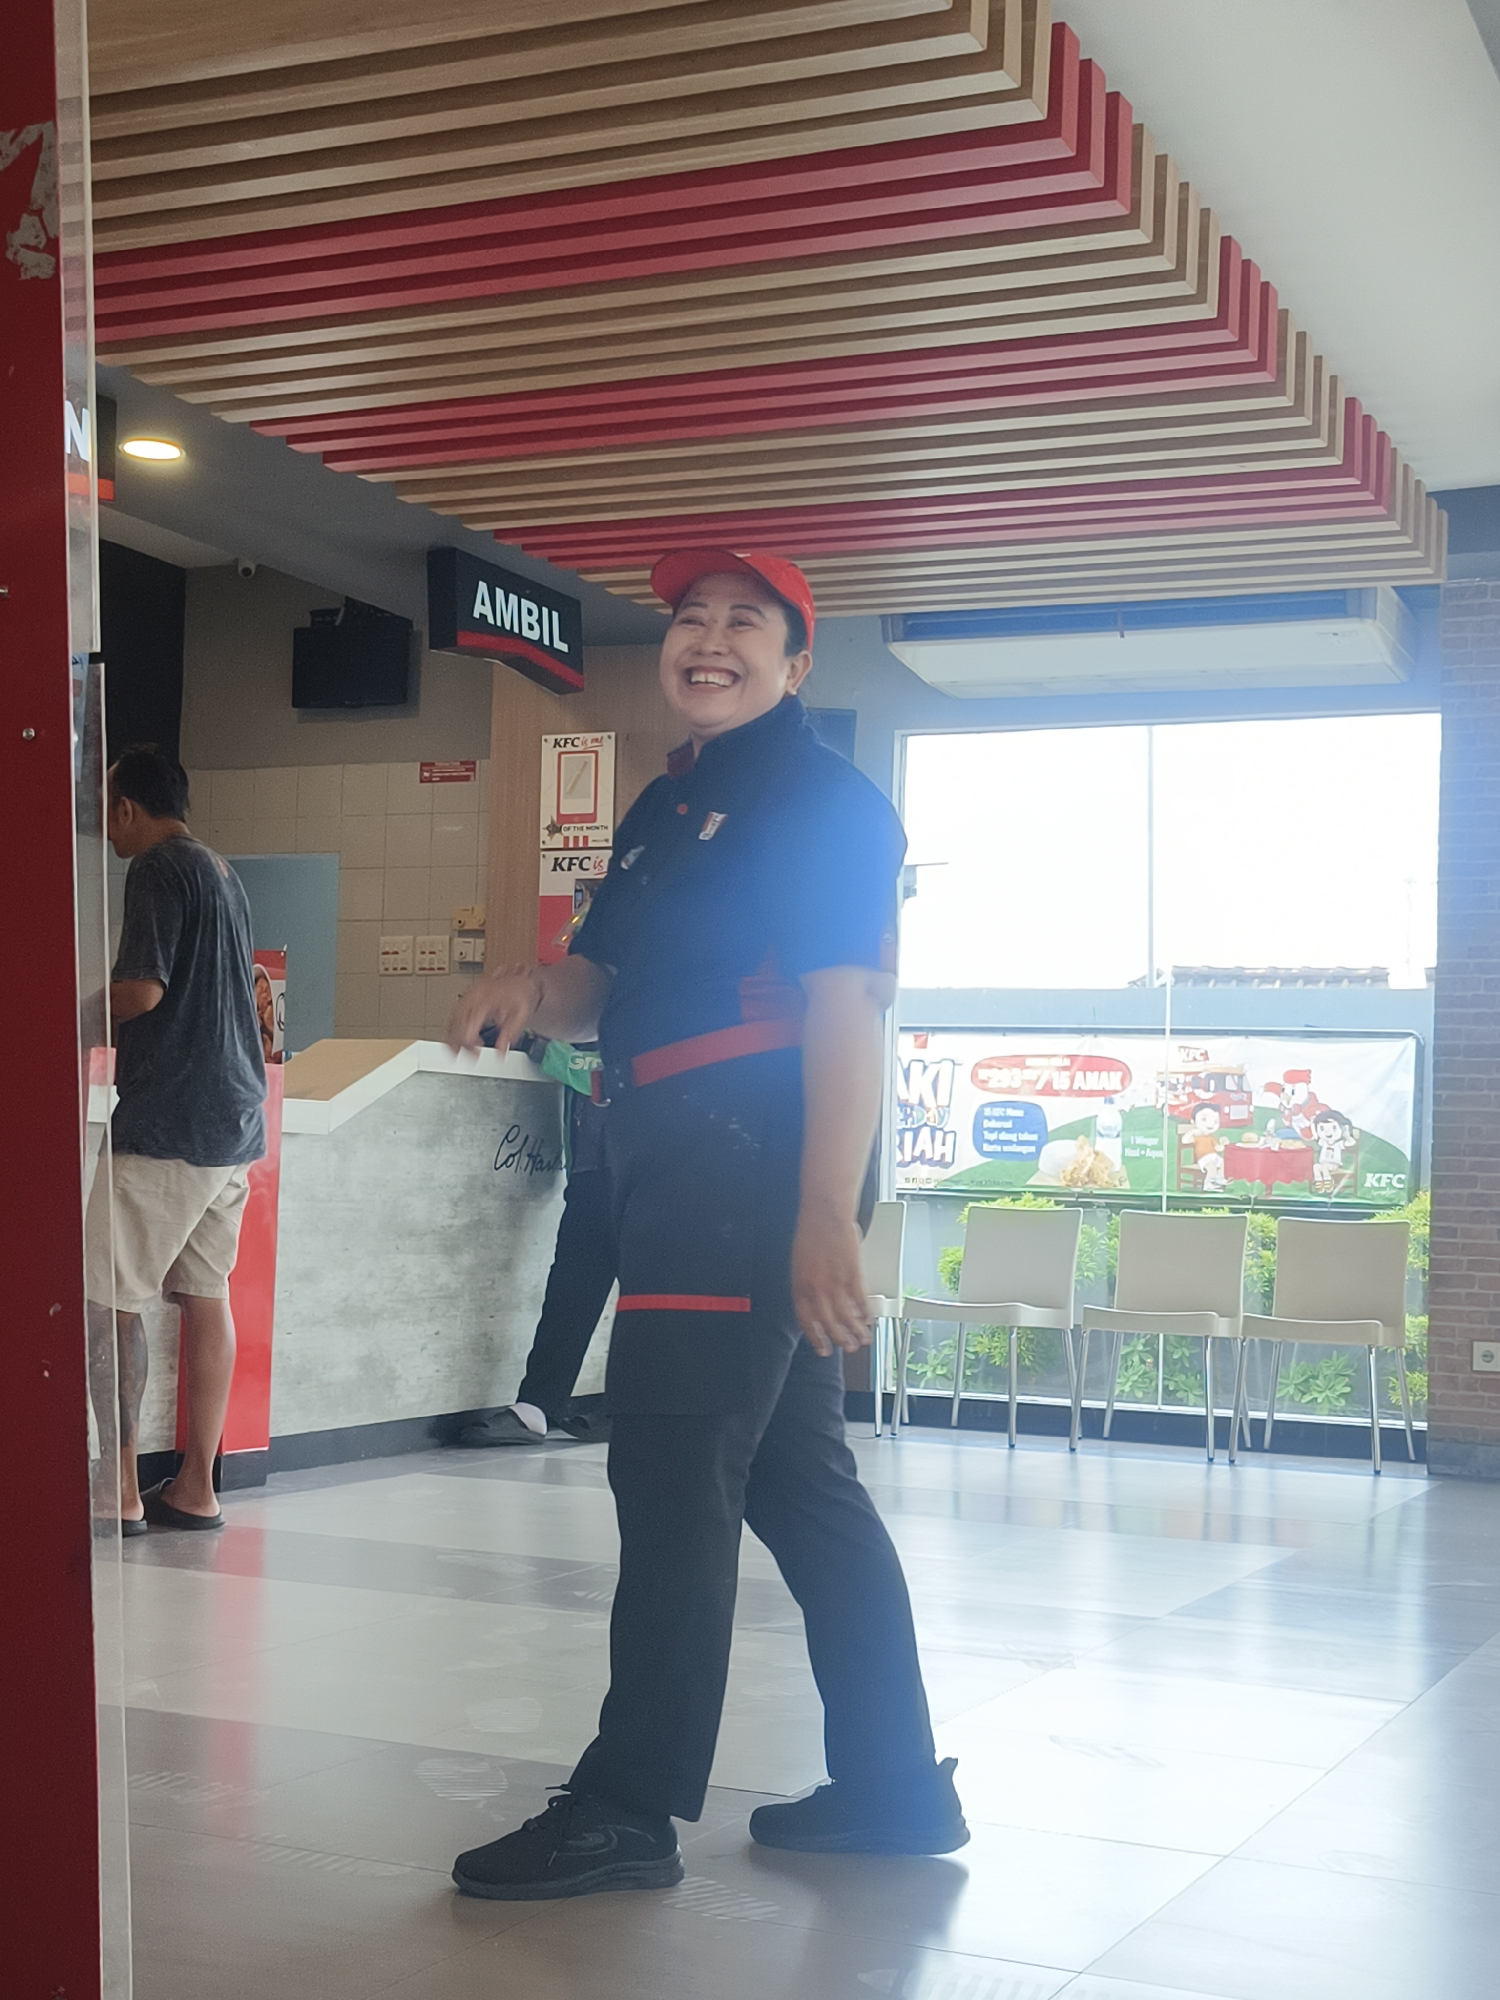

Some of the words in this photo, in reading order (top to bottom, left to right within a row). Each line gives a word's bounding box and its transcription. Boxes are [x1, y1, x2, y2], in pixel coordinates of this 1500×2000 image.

[473, 580, 569, 653] AMBIL
[553, 737, 580, 749] KFC
[551, 856, 592, 872] KFC
[1364, 1173, 1406, 1189] KFC
